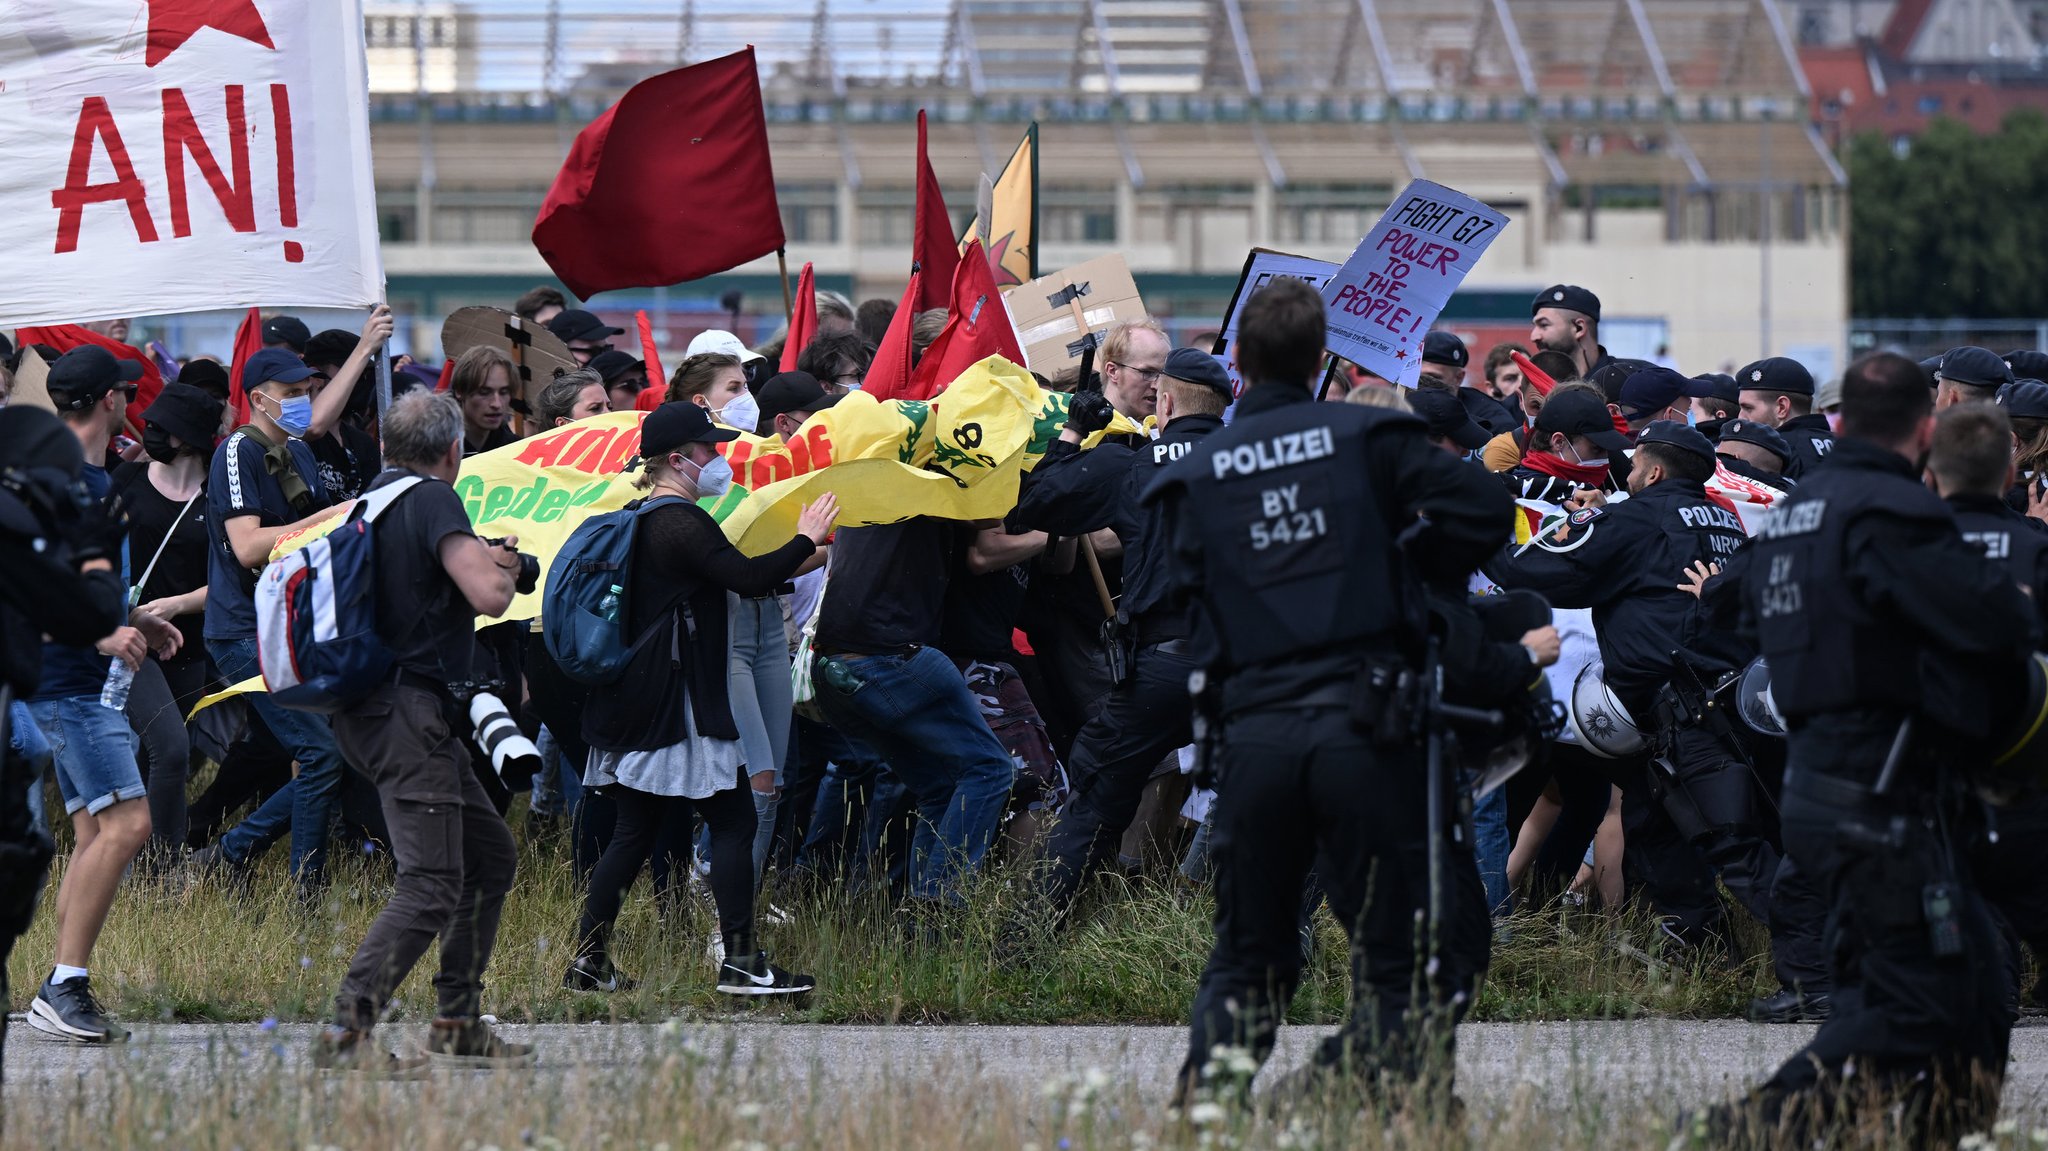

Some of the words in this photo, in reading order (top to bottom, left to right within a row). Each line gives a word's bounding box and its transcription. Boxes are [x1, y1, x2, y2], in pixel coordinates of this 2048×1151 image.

[51, 83, 304, 264] AN!
[1392, 197, 1465, 235] FIGHT
[1452, 215, 1495, 245] G7
[1377, 228, 1460, 276] POWER
[1383, 256, 1411, 280] TO
[1362, 271, 1408, 302] THE
[1211, 425, 1335, 480] POLIZEI
[1261, 482, 1300, 519] BY
[1249, 507, 1328, 551] 5421
